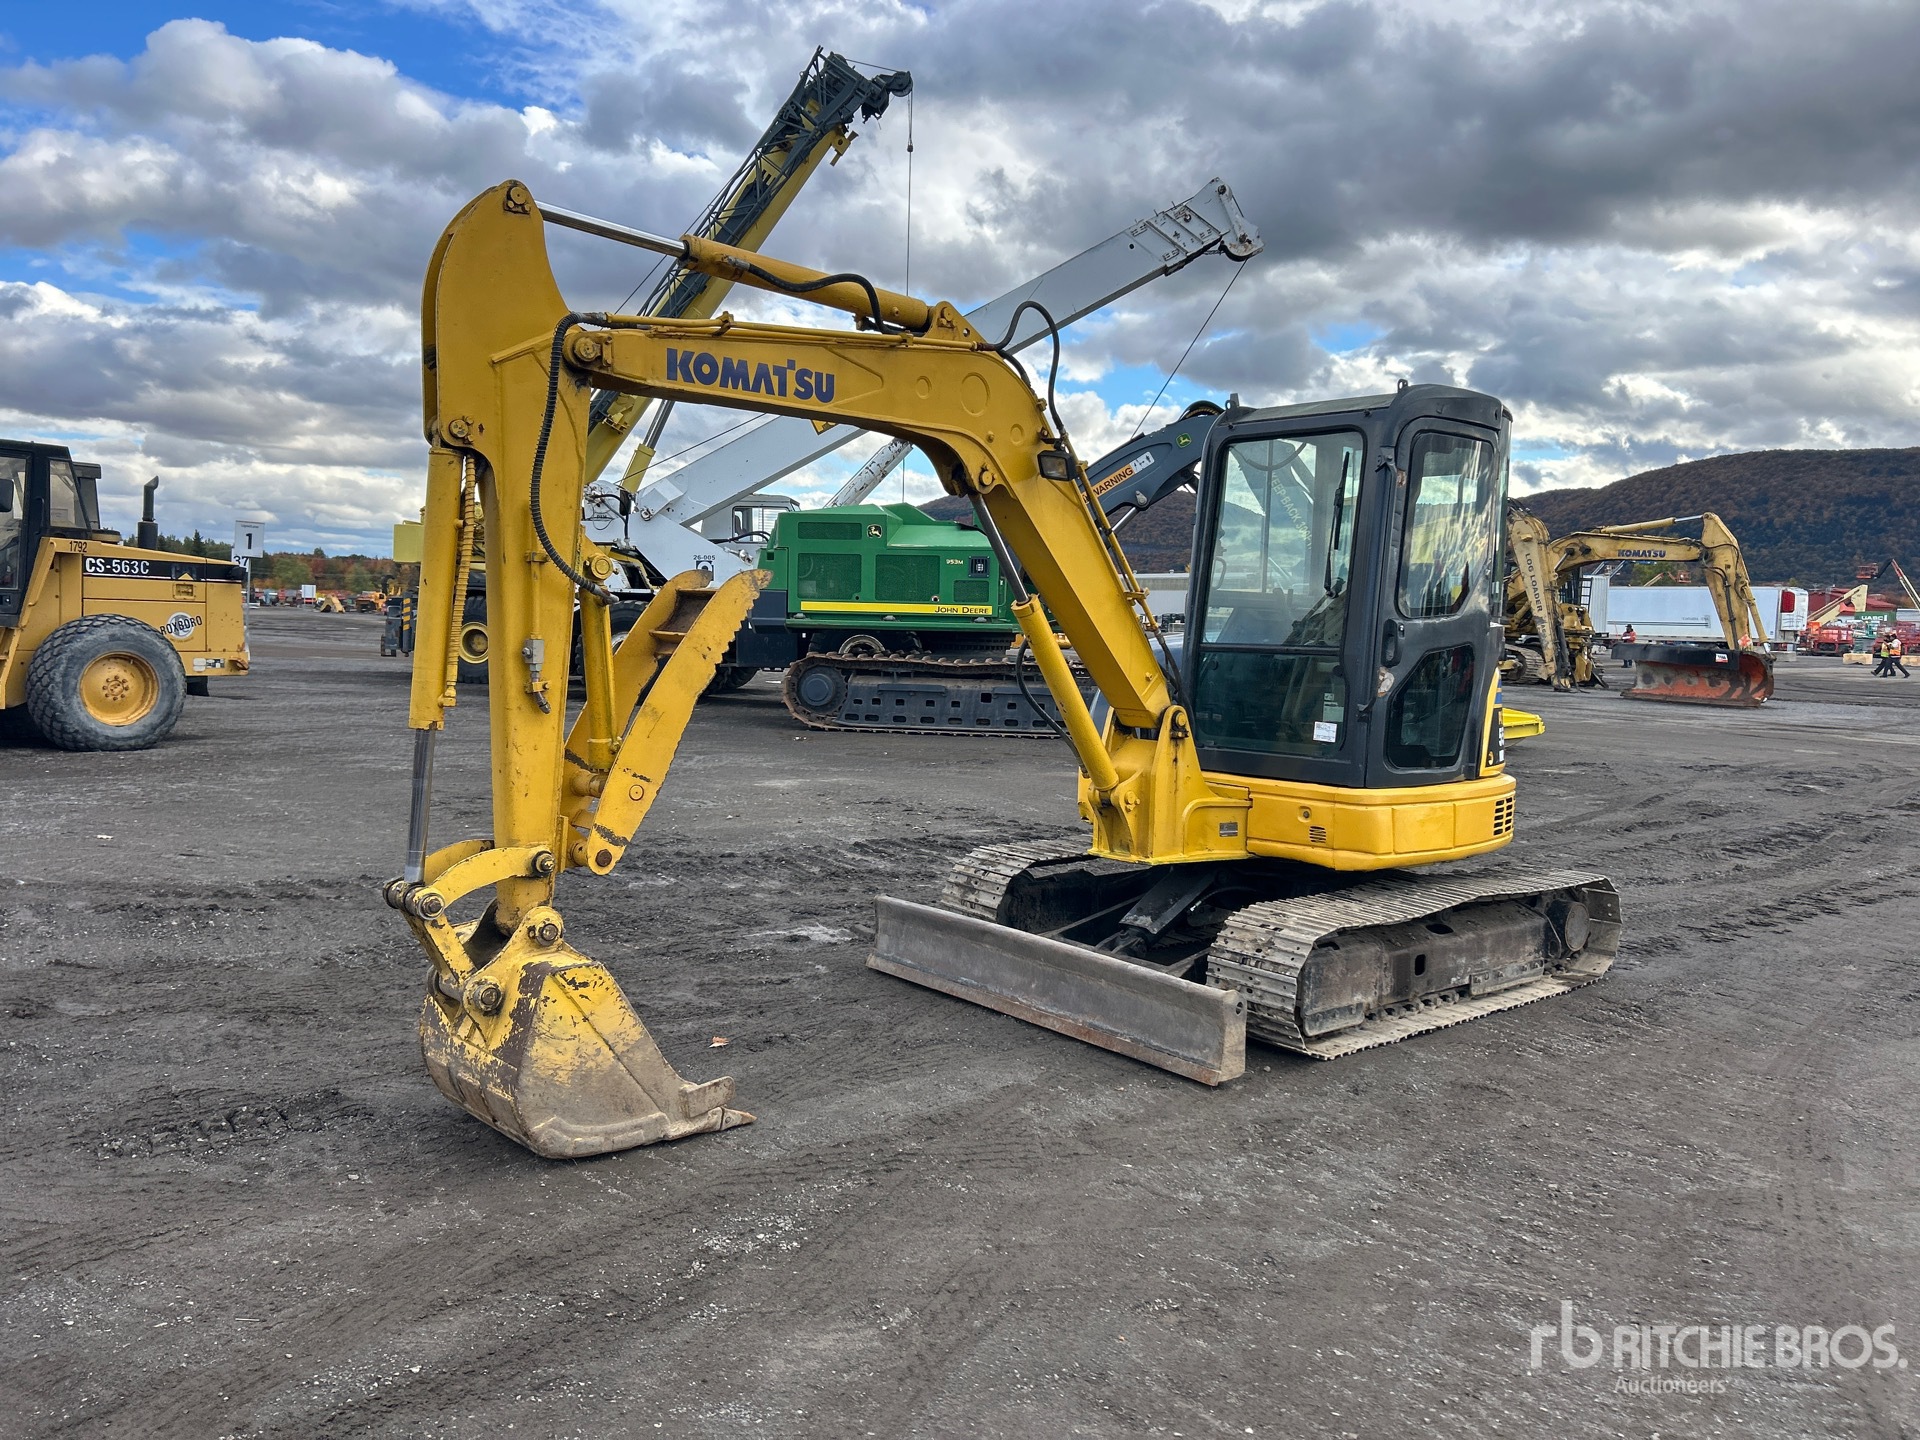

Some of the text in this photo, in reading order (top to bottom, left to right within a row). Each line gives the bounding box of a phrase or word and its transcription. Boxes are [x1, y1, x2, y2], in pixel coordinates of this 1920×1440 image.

[667, 348, 835, 403] KOMATSU
[1280, 496, 1302, 523] BACK
[69, 541, 88, 553] 1792
[245, 533, 253, 549] 1
[1617, 549, 1667, 558] KOMATSU
[85, 557, 150, 575] CS-563C
[1525, 553, 1543, 613] LOG LOADER
[935, 606, 989, 614] JOHN DEERE
[159, 615, 203, 636] ROXBORO
